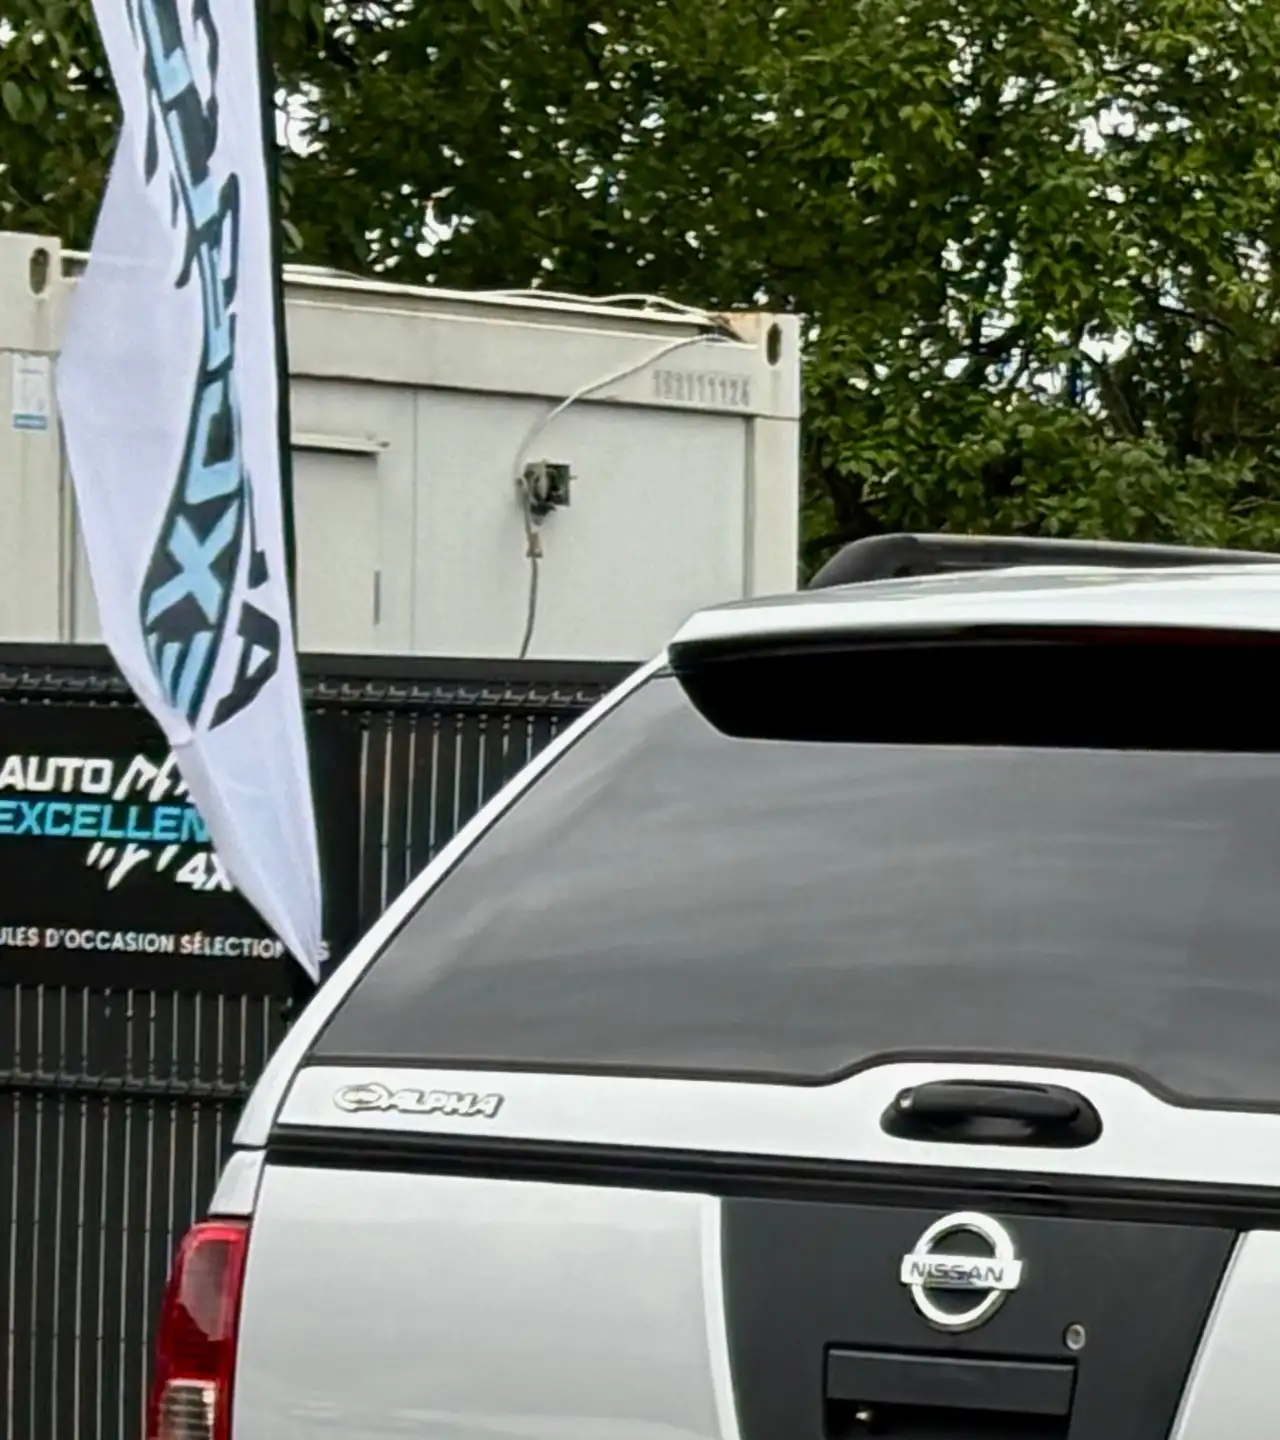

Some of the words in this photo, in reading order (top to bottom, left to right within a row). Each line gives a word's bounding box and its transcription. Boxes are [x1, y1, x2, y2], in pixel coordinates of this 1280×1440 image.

[0, 755, 113, 794] AUTO
[44, 927, 175, 953] D'OCCASION
[909, 1260, 1004, 1283] NISSAN
